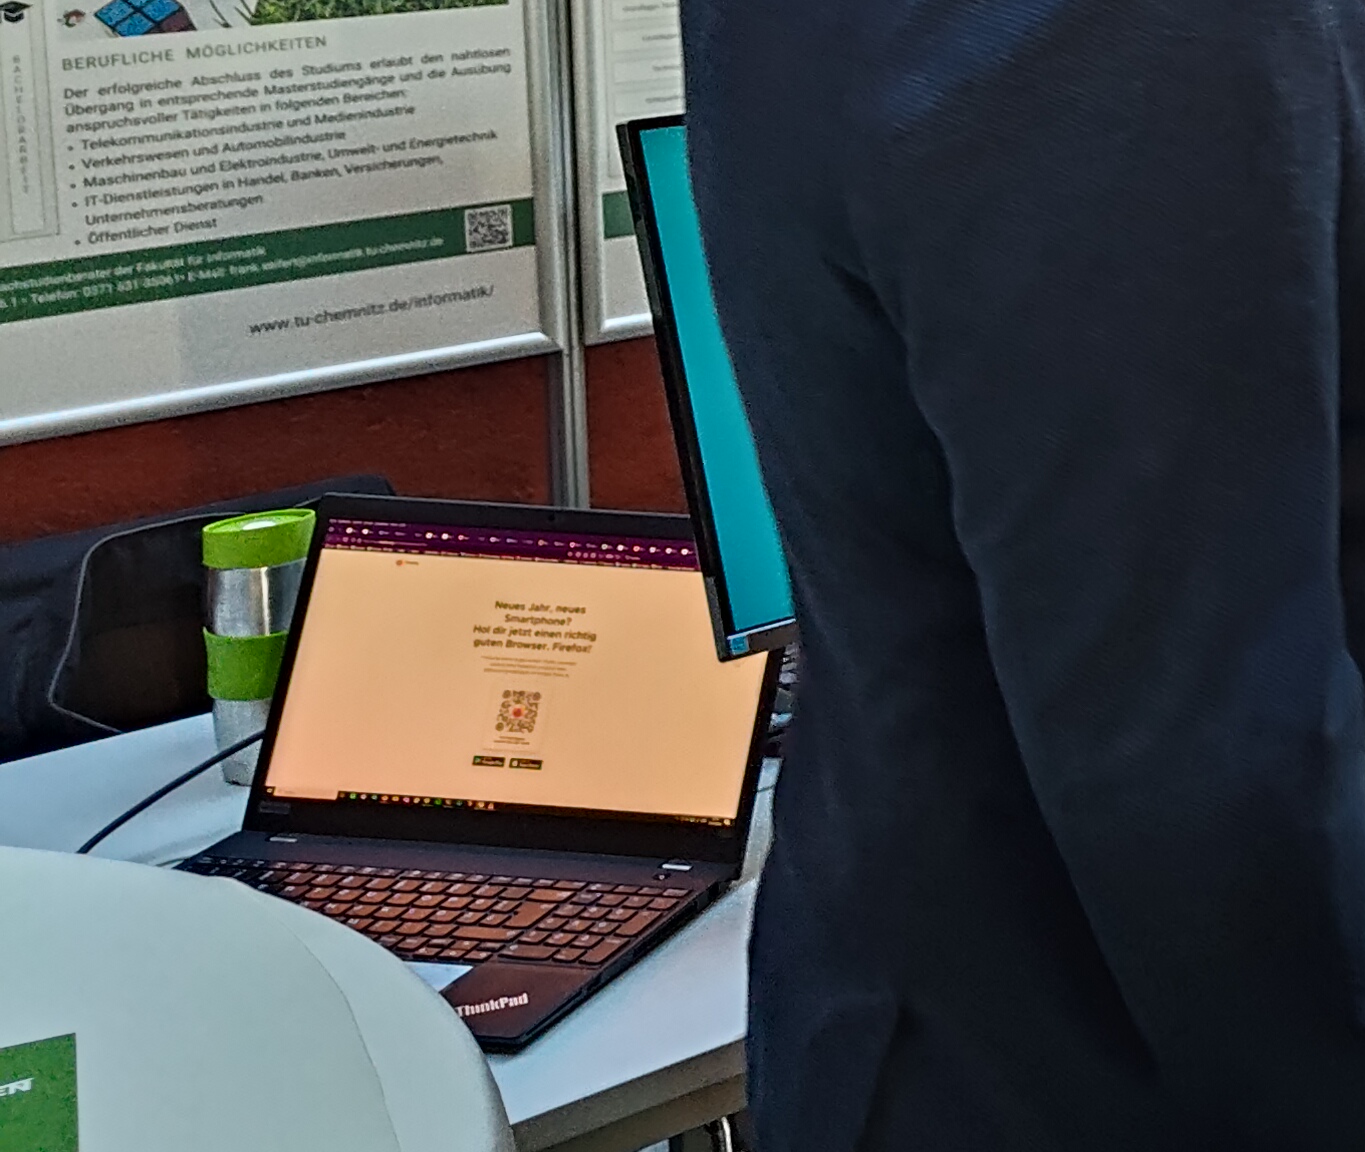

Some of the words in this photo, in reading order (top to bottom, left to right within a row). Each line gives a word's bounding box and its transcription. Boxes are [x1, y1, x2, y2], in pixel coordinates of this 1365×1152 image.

[62, 49, 175, 71] BERUFLICHE
[186, 36, 327, 60] MÖGLICHKEITEN
[64, 87, 88, 99] Der
[98, 77, 182, 95] erfolgreiche
[192, 71, 261, 86] Abschluss
[269, 67, 294, 79] des
[302, 61, 362, 76] Studiums
[65, 101, 134, 115] Übergang
[140, 96, 152, 108] in
[157, 86, 258, 106] entsprechende
[66, 111, 177, 133] anspruchsvoller
[82, 148, 189, 168] Verkehrswesen
[193, 142, 218, 156] und
[83, 166, 186, 187] Maschinenbau
[190, 161, 215, 175] und
[495, 601, 525, 611] Neues
[556, 605, 586, 614] neues
[505, 614, 572, 626] Smartphone?
[473, 625, 490, 634] Hol
[492, 625, 507, 634] dir
[508, 628, 532, 637] jetzt
[534, 629, 562, 638] einen
[564, 630, 597, 642] richtig
[473, 639, 503, 648] guten
[455, 992, 529, 1017] ThinkPad
